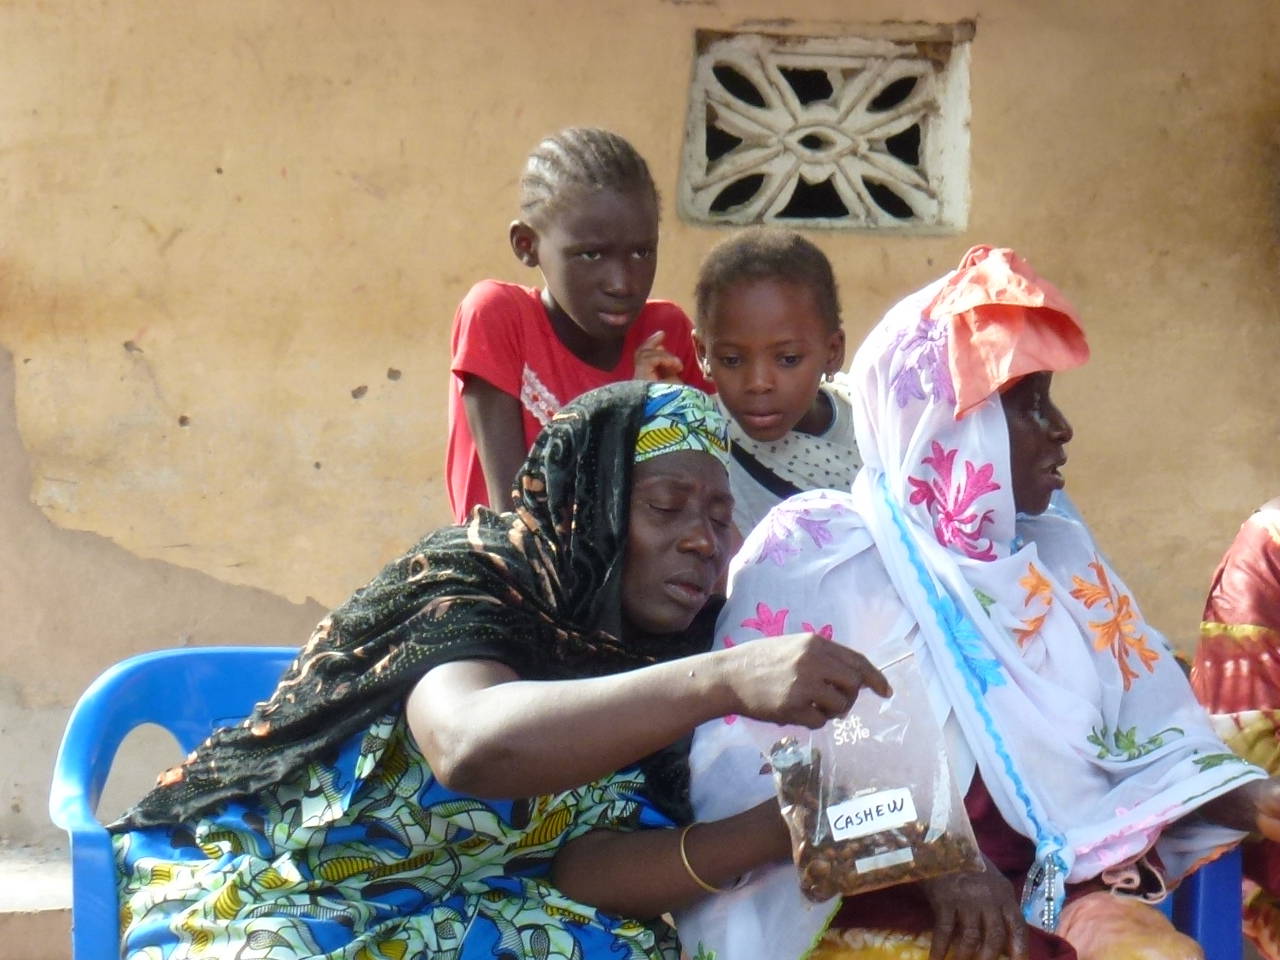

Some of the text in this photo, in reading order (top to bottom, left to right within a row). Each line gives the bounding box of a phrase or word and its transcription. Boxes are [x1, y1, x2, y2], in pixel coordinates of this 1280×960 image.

[833, 715, 862, 732] Soft
[834, 727, 870, 745] Style
[834, 798, 904, 831] CASHEW
